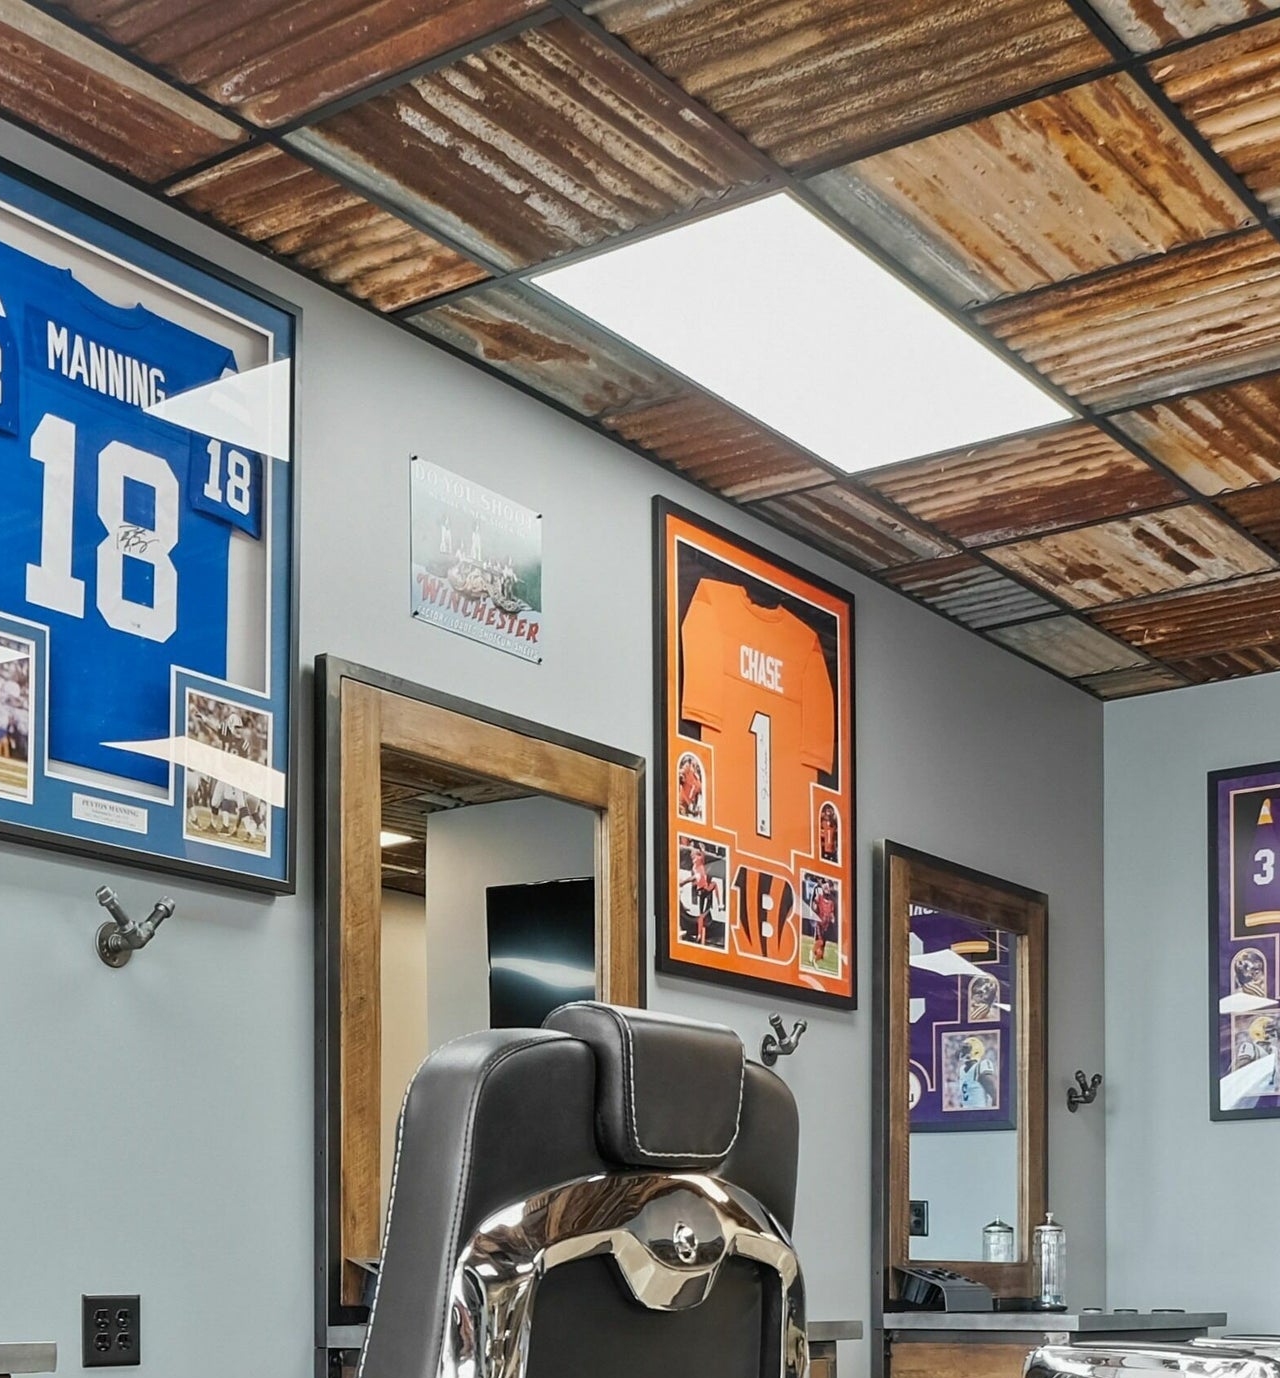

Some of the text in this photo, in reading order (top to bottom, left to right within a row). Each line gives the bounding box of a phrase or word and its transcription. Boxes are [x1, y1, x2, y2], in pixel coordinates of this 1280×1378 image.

[46, 319, 166, 410] MANNING
[204, 438, 252, 516] 18
[25, 412, 180, 643] 18
[417, 573, 539, 643] WINCHESTER
[740, 644, 784, 693] CHASE
[748, 711, 771, 839] 1
[1253, 849, 1275, 885] 3
